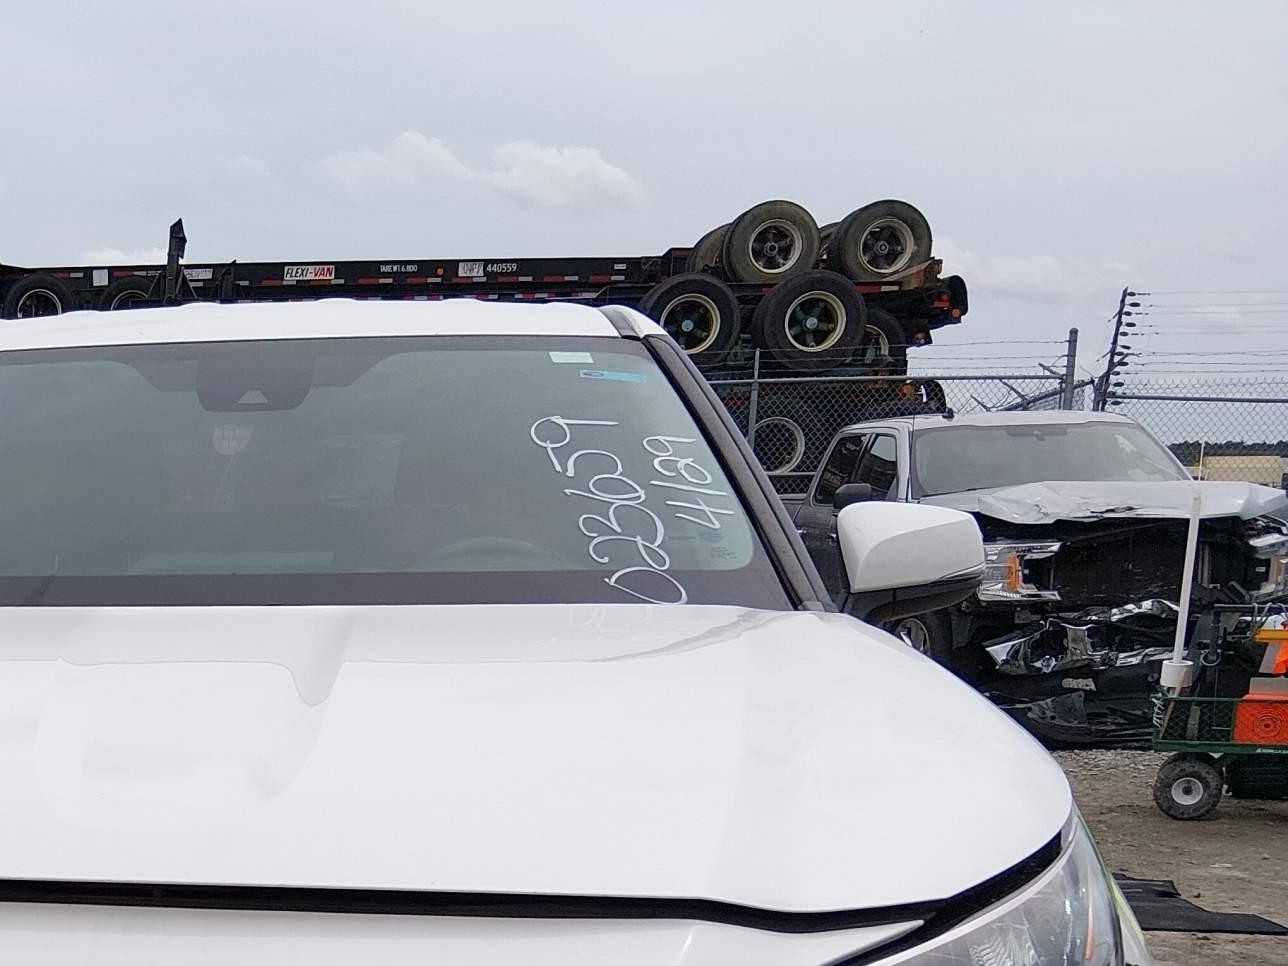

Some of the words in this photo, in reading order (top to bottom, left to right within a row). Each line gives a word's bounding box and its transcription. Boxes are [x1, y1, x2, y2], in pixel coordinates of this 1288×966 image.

[285, 267, 334, 278] FLEXI-VAN
[486, 263, 517, 273] 440559
[642, 435, 735, 529] 4129
[530, 415, 689, 605] 023659
